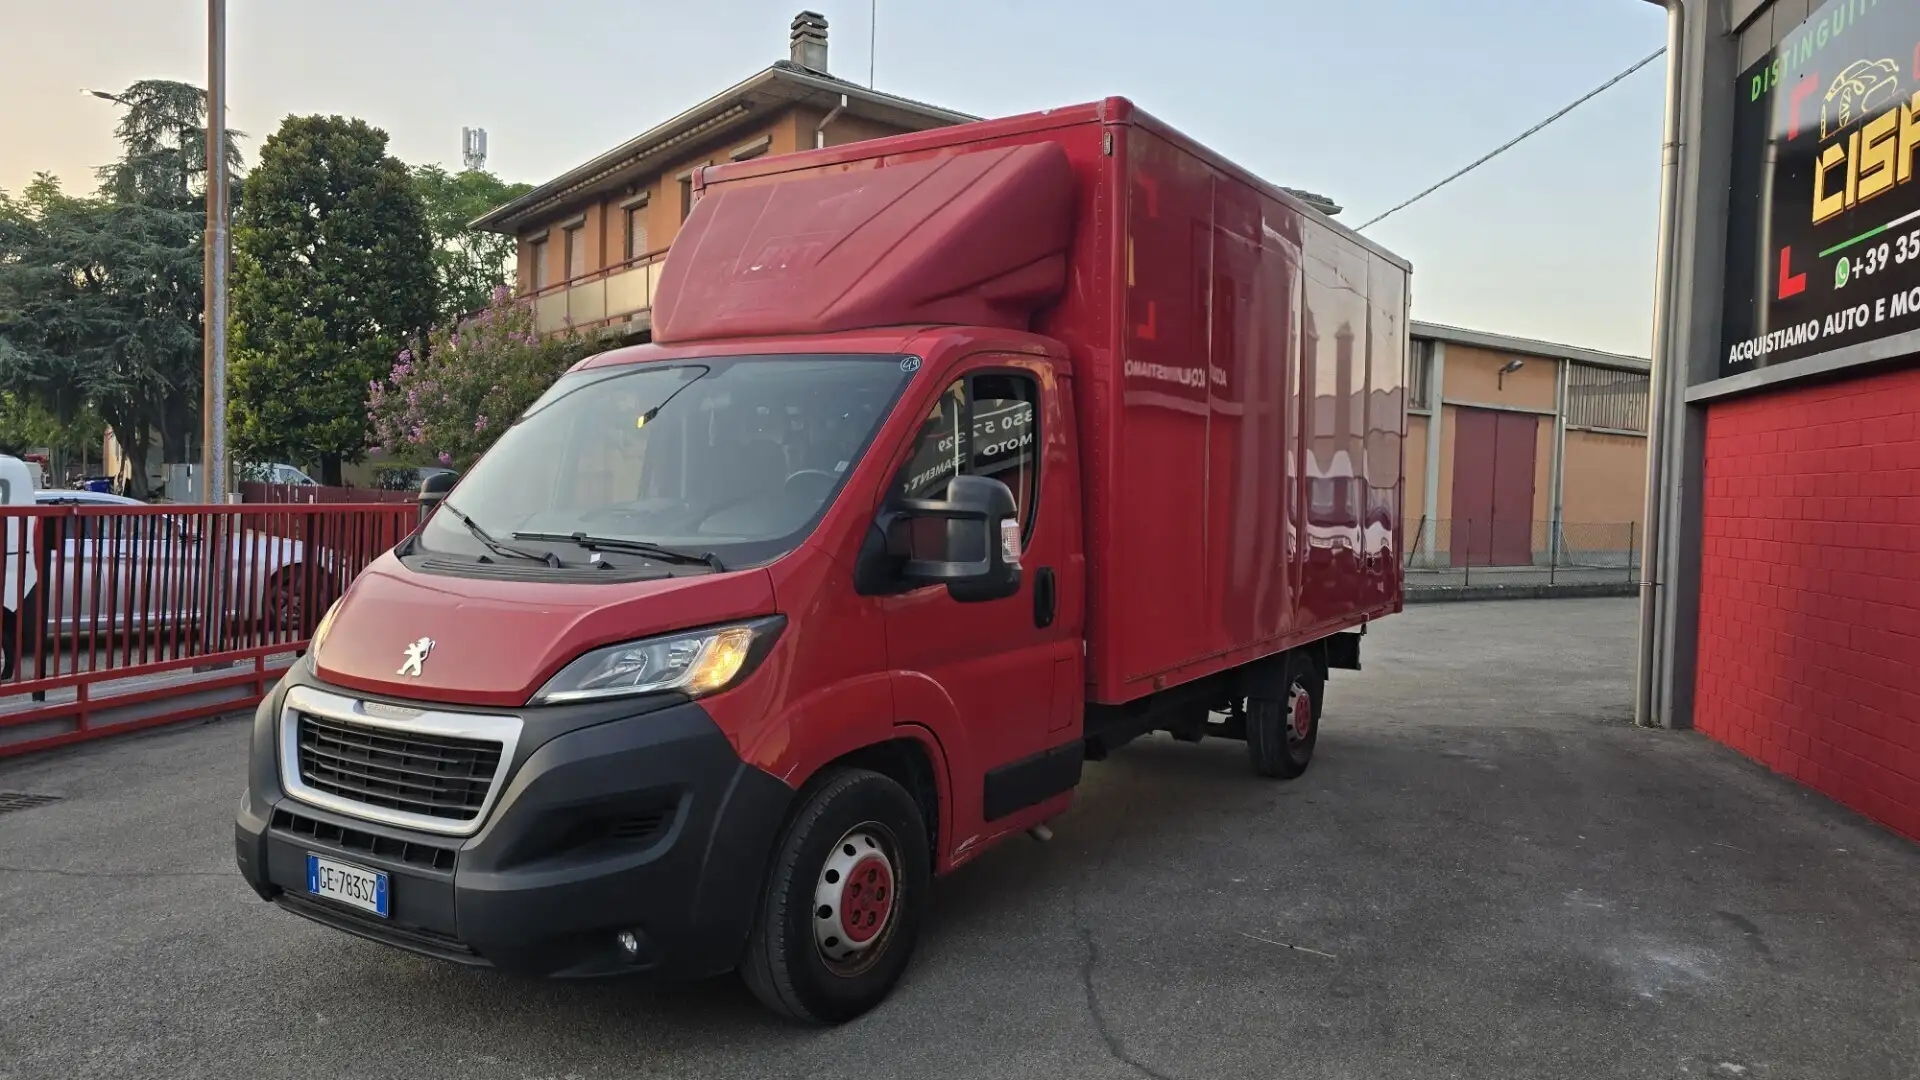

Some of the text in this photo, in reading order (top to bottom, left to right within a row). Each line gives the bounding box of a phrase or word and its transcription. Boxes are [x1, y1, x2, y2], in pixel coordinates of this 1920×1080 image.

[1852, 229, 1920, 279] +39 35
[1729, 319, 1819, 364] ACQUISTIAMO
[1822, 304, 1870, 337] AUTO
[1874, 298, 1885, 322] E
